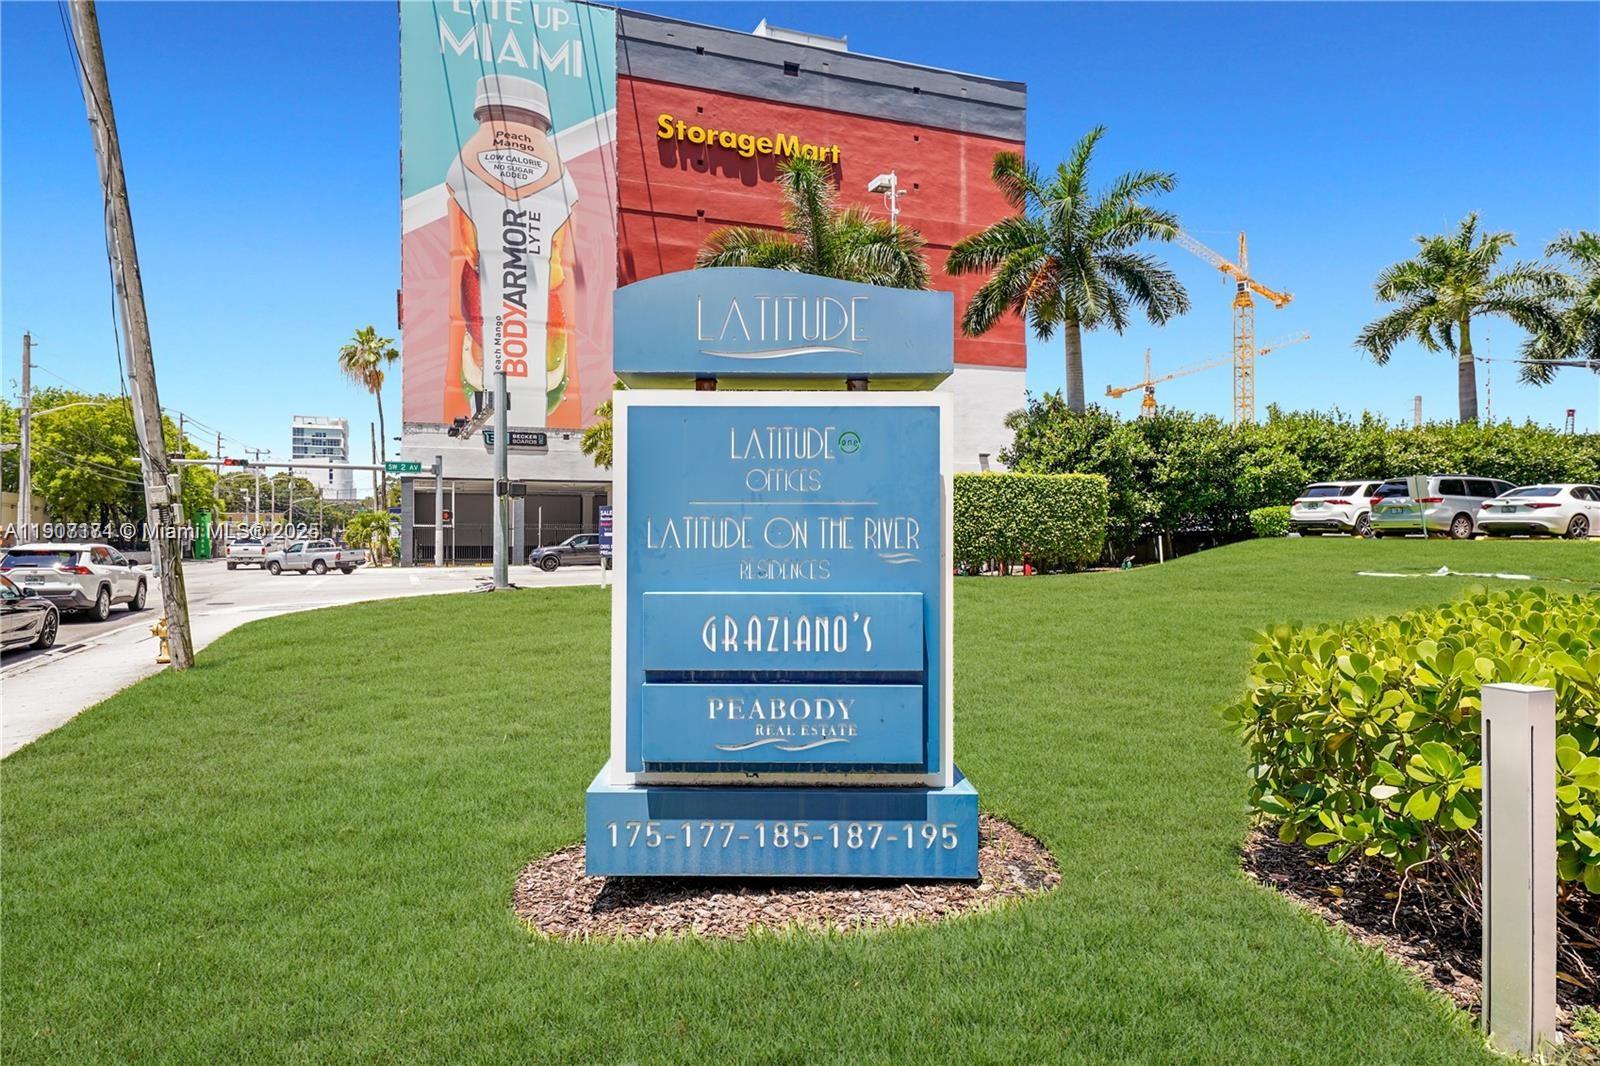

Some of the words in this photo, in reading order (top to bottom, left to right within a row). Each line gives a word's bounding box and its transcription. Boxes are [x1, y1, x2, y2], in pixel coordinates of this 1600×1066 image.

[440, 15, 583, 78] MIAMI
[493, 139, 535, 152] Mango
[495, 130, 532, 143] Peach
[657, 113, 841, 164] StorageMart
[484, 153, 505, 161] LOW
[505, 155, 543, 168] CALORIE
[506, 165, 534, 175] SUGAR
[499, 171, 528, 180] ADDED
[529, 210, 541, 255] LYTE
[502, 208, 528, 378] BODYARMOR
[494, 315, 504, 346] Mango
[697, 295, 871, 342] LATITUDE
[730, 426, 836, 460] LATITUDE
[400, 463, 407, 471] 2
[745, 468, 823, 493] OFFICES
[646, 516, 753, 550] LATITUDE
[763, 516, 808, 550] ON
[817, 516, 855, 550] THE
[863, 516, 921, 550] RIVER
[739, 559, 831, 581] RESIDENCES
[701, 611, 873, 653] GRAZIANO'S
[706, 697, 856, 721] PEABODY
[754, 724, 797, 737] REAL
[801, 724, 858, 738] ESTATE
[606, 820, 959, 850] 175-177-185-187-195
